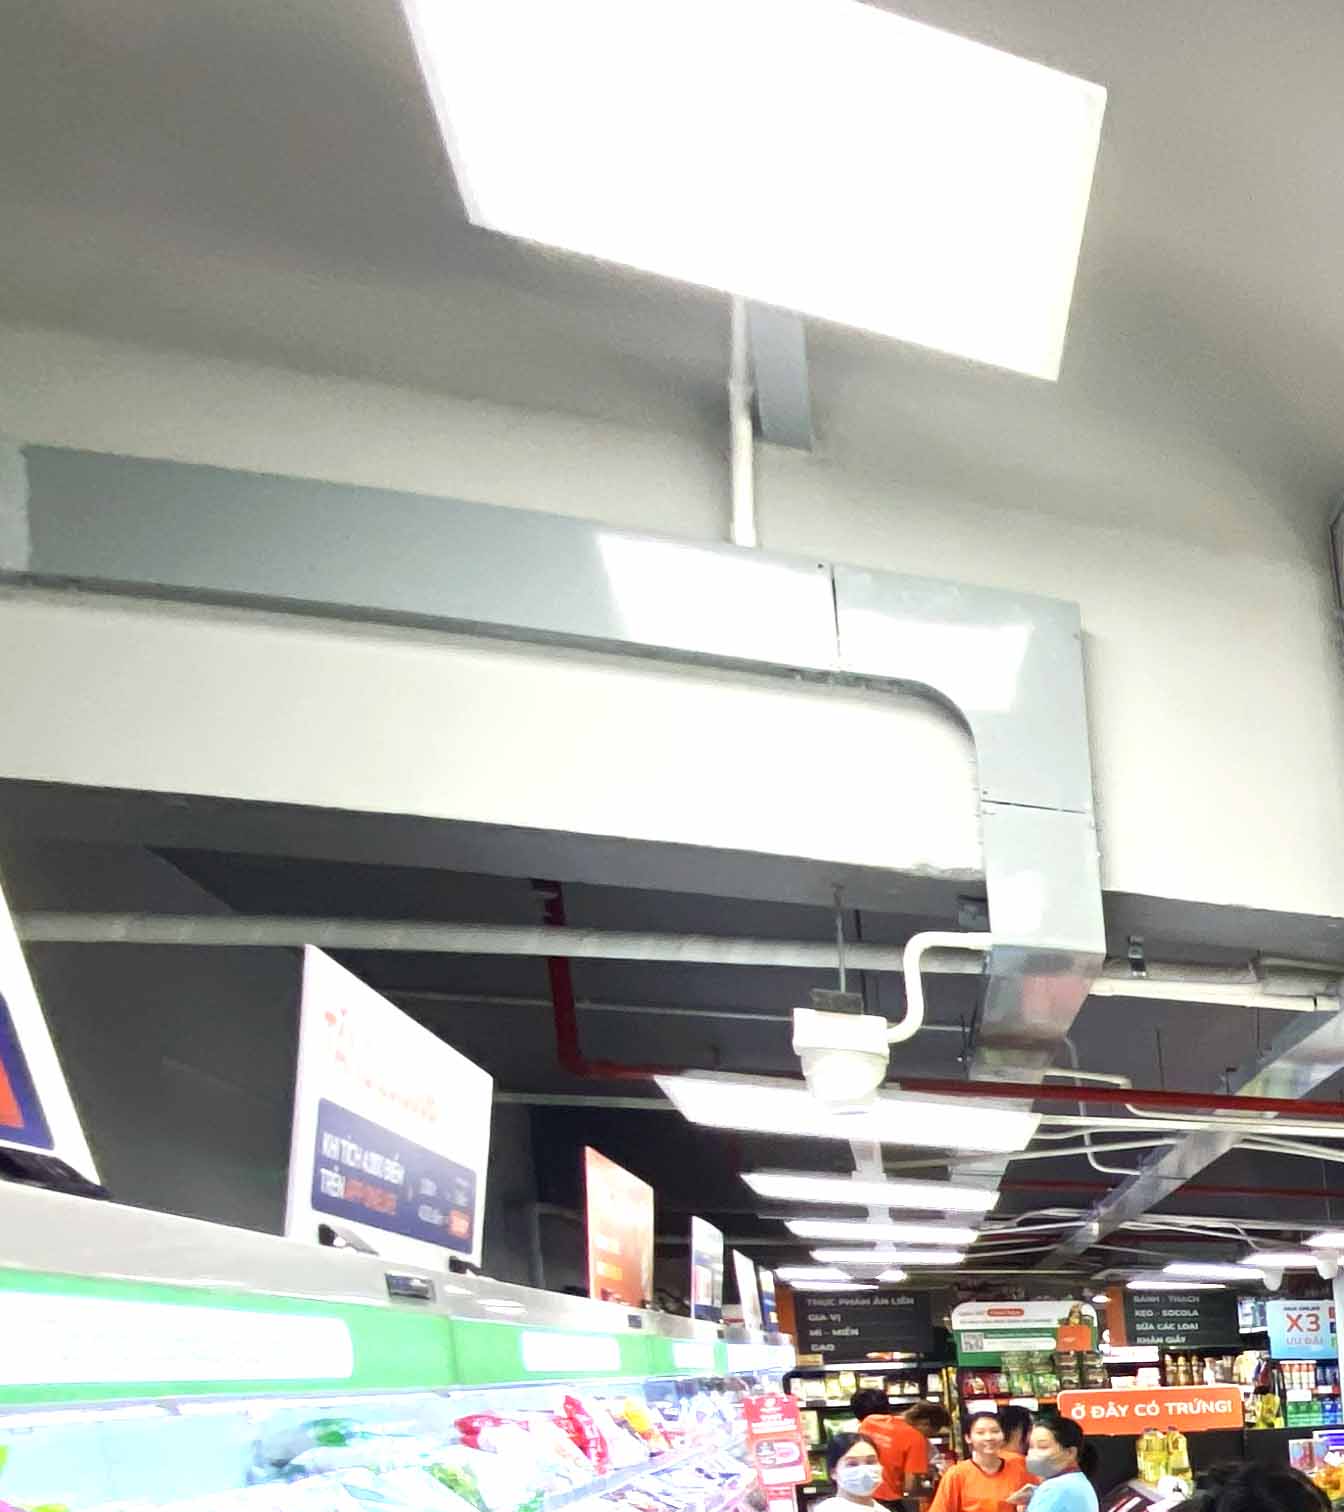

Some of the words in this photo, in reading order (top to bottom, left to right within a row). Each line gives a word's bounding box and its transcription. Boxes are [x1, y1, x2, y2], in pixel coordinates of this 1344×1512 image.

[1286, 1313, 1321, 1333] X3
[1071, 1402, 1087, 1421] Ở
[1091, 1401, 1130, 1420] ĐÂY
[1134, 1399, 1161, 1417] CÓ
